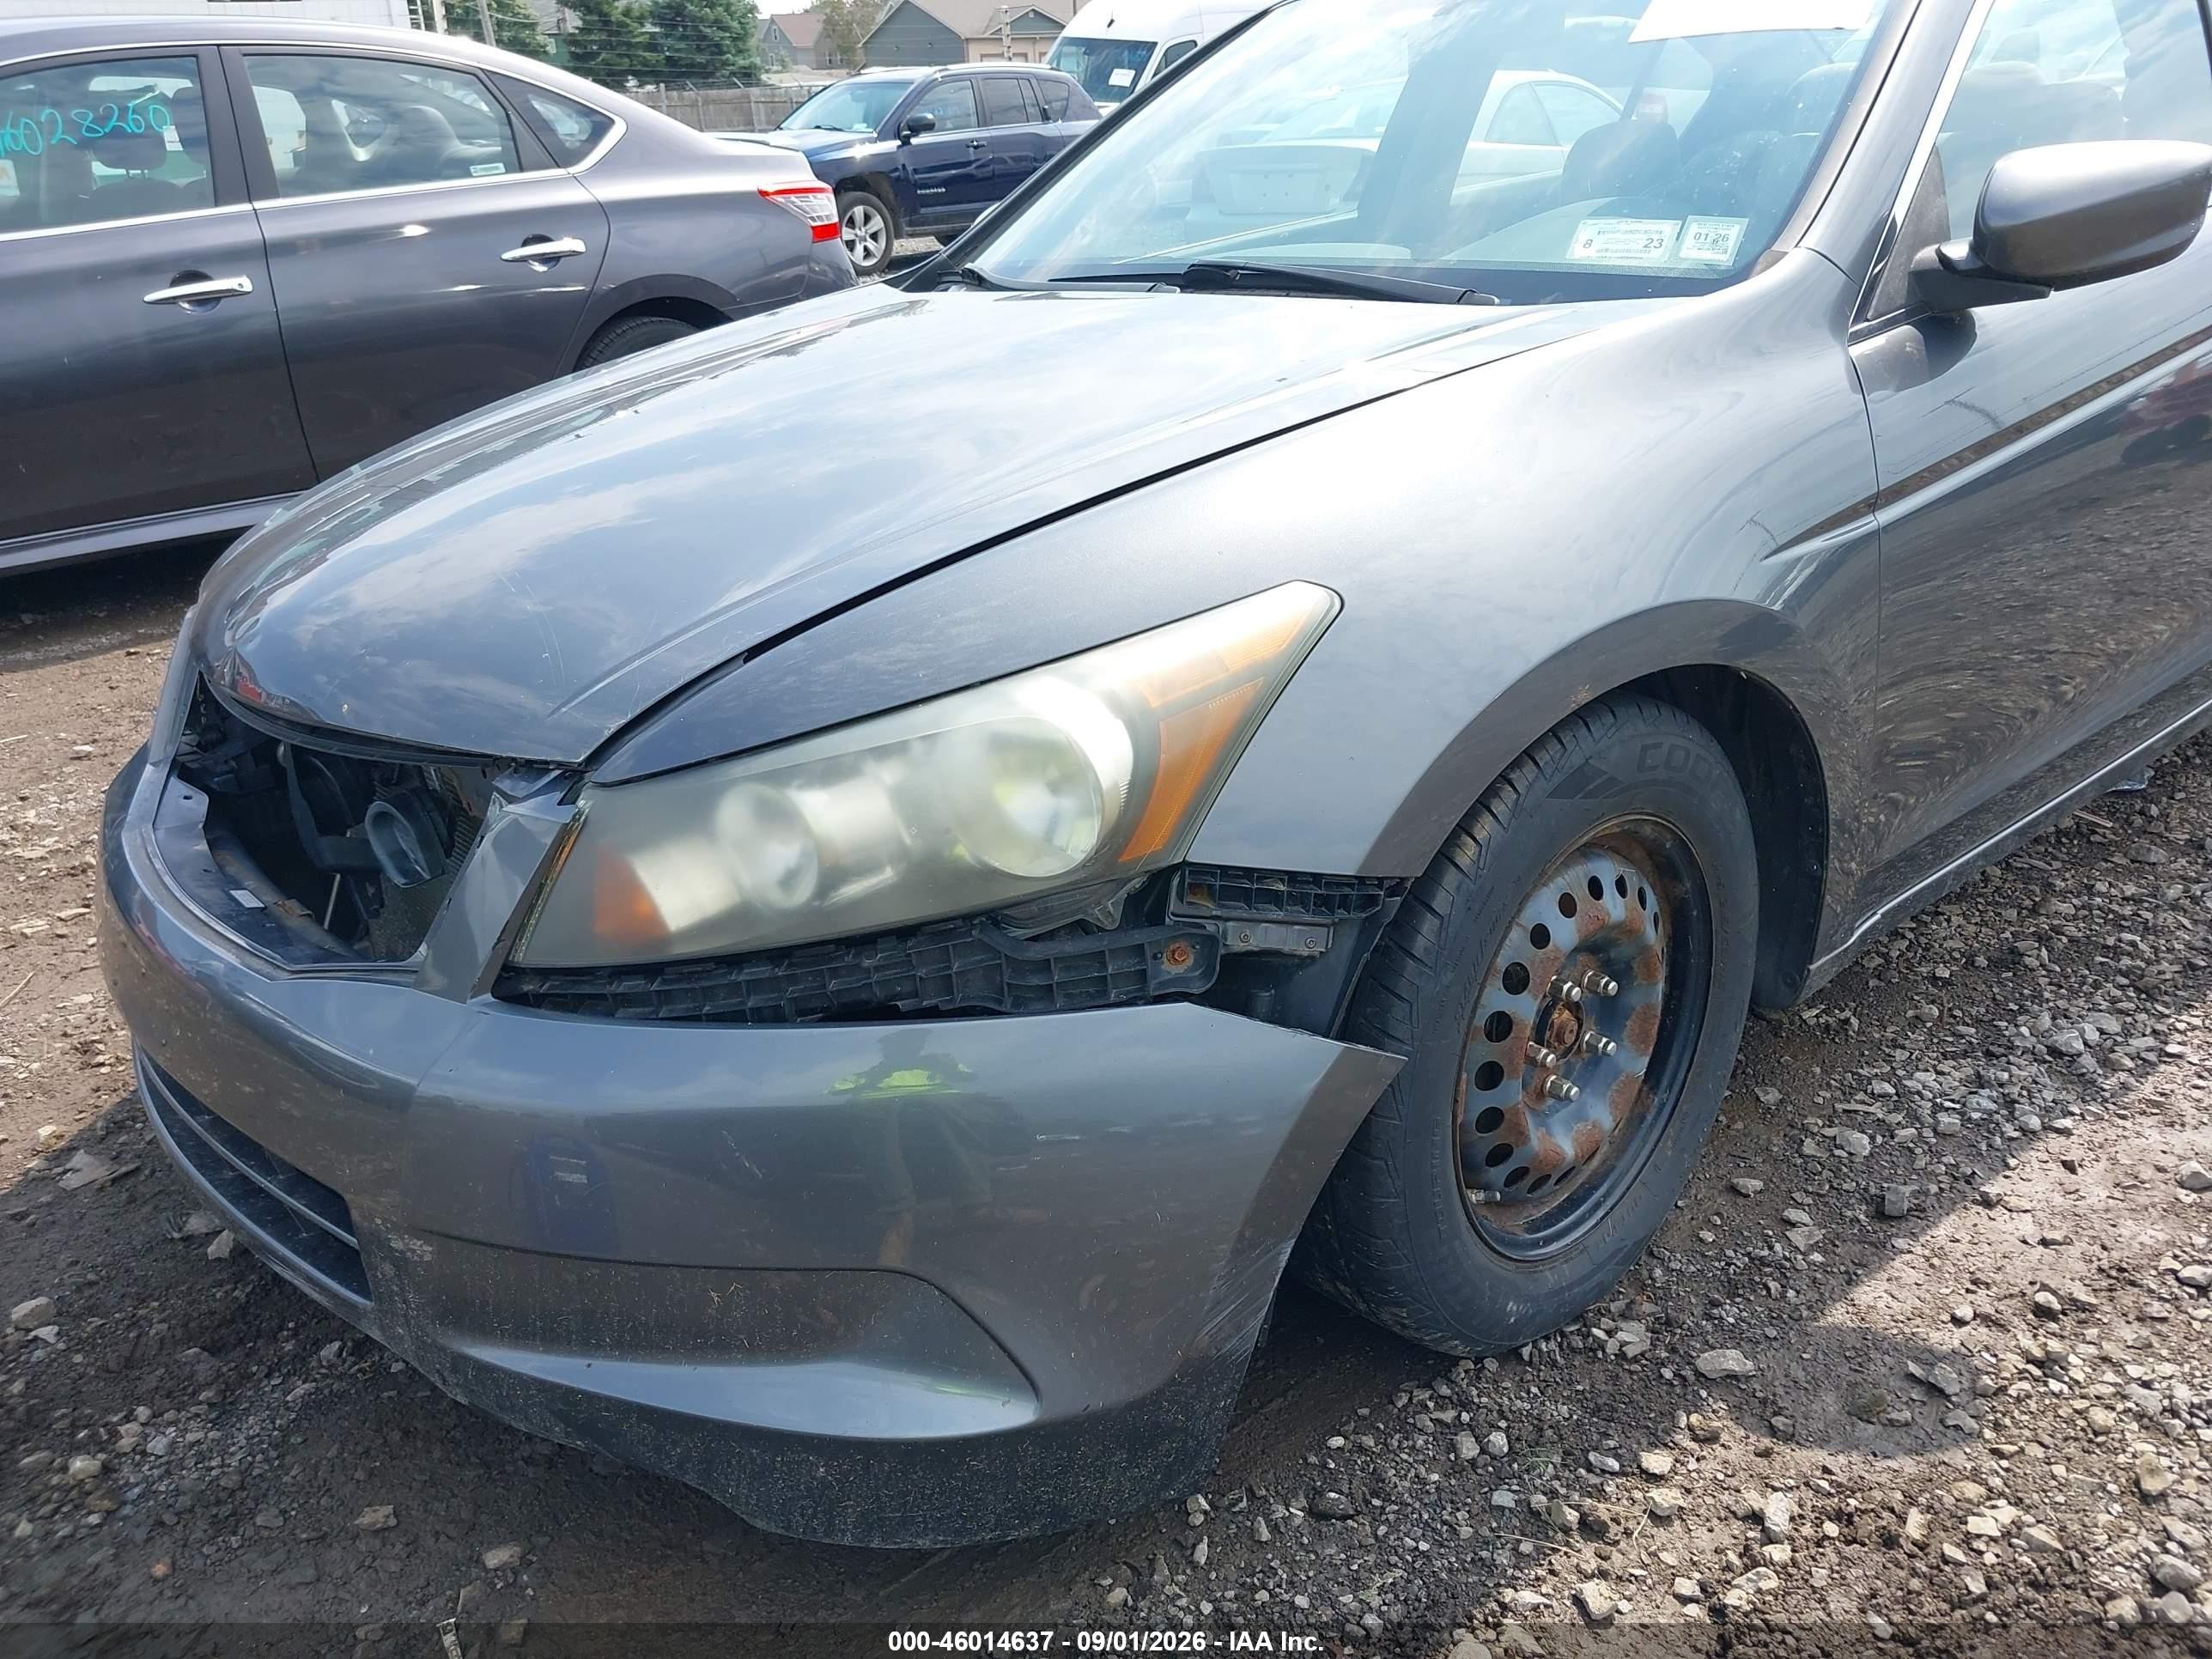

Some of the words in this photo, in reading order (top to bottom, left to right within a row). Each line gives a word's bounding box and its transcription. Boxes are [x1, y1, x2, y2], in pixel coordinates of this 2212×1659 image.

[0, 102, 171, 158] 6028260
[1693, 231, 1710, 242] 01
[1582, 238, 1594, 249] 8
[1642, 237, 1664, 249] 23
